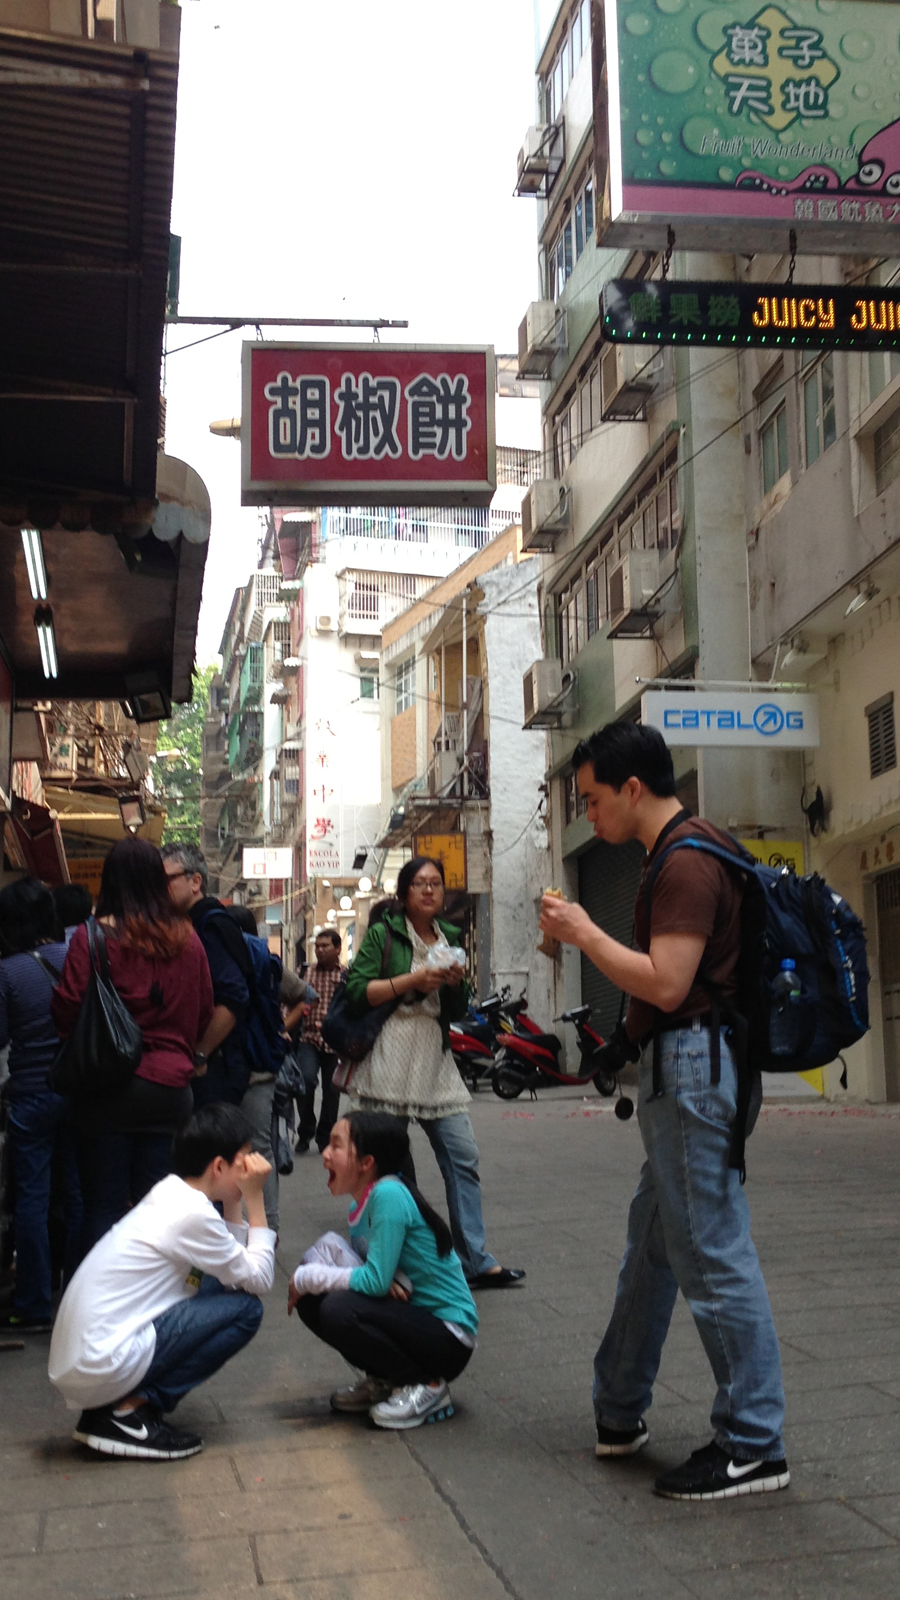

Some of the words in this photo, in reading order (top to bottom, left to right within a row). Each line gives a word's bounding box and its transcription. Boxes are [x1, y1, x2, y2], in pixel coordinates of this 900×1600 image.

[726, 25, 824, 67] 菓子
[727, 76, 825, 117] 天地
[700, 134, 745, 157] Fruit
[751, 137, 858, 161] Wonderland
[850, 299, 900, 332] JUI
[264, 370, 472, 461] 胡椒餅
[309, 850, 340, 858] ESCOLA
[309, 860, 326, 869] KAO
[327, 860, 340, 869] YIP
